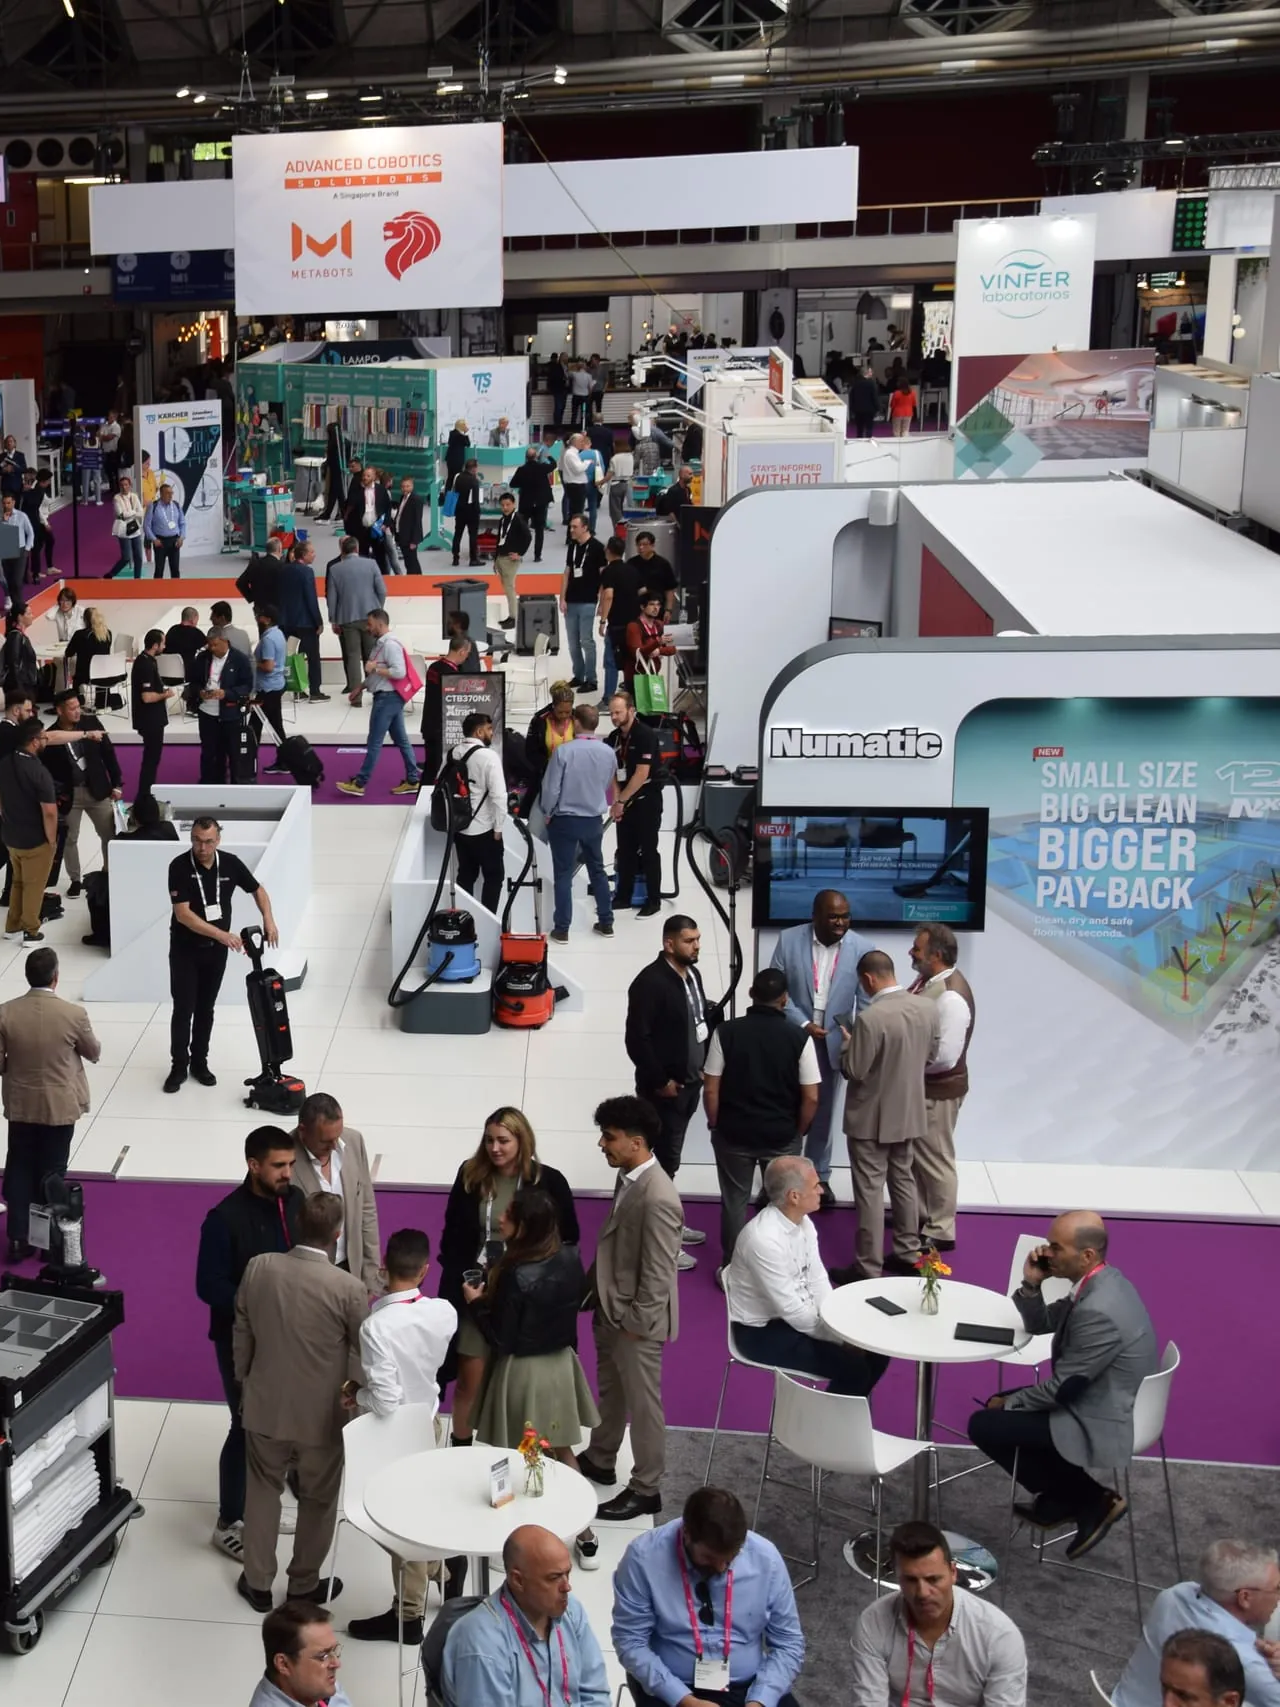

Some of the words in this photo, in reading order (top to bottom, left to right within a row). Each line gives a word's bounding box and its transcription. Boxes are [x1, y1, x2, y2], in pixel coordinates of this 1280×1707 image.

[284, 157, 363, 174] ADVANCED
[367, 153, 443, 171] COBOTICS
[297, 174, 429, 188] SOLUTIONS
[339, 191, 376, 200] Singapore
[377, 190, 399, 198] Brand
[291, 267, 353, 280] METABOTS
[980, 271, 1070, 290] VINFER
[981, 290, 1071, 303] laboratorios
[342, 354, 381, 366] LAMPO
[750, 464, 777, 472] STAYS
[779, 463, 822, 472] INFORMED
[750, 473, 791, 486] WITH
[445, 694, 491, 703] CTB370NX
[770, 727, 943, 759] Numatic
[1038, 748, 1061, 757] NEW
[1041, 761, 1131, 789] SMALL
[1138, 761, 1198, 789] SIZE
[1040, 792, 1090, 824] BIG
[1098, 792, 1197, 824] CLEAN
[759, 825, 787, 835] NEW
[1038, 827, 1197, 872] BIGGER
[1036, 875, 1195, 910] PAY-BACK
[1034, 915, 1066, 926] Clean,
[1068, 916, 1087, 928] dry
[1089, 916, 1109, 926] and
[1110, 917, 1133, 926] safe
[1033, 928, 1063, 937] floors
[1066, 929, 1077, 937] in
[1078, 928, 1126, 938] seconds.
